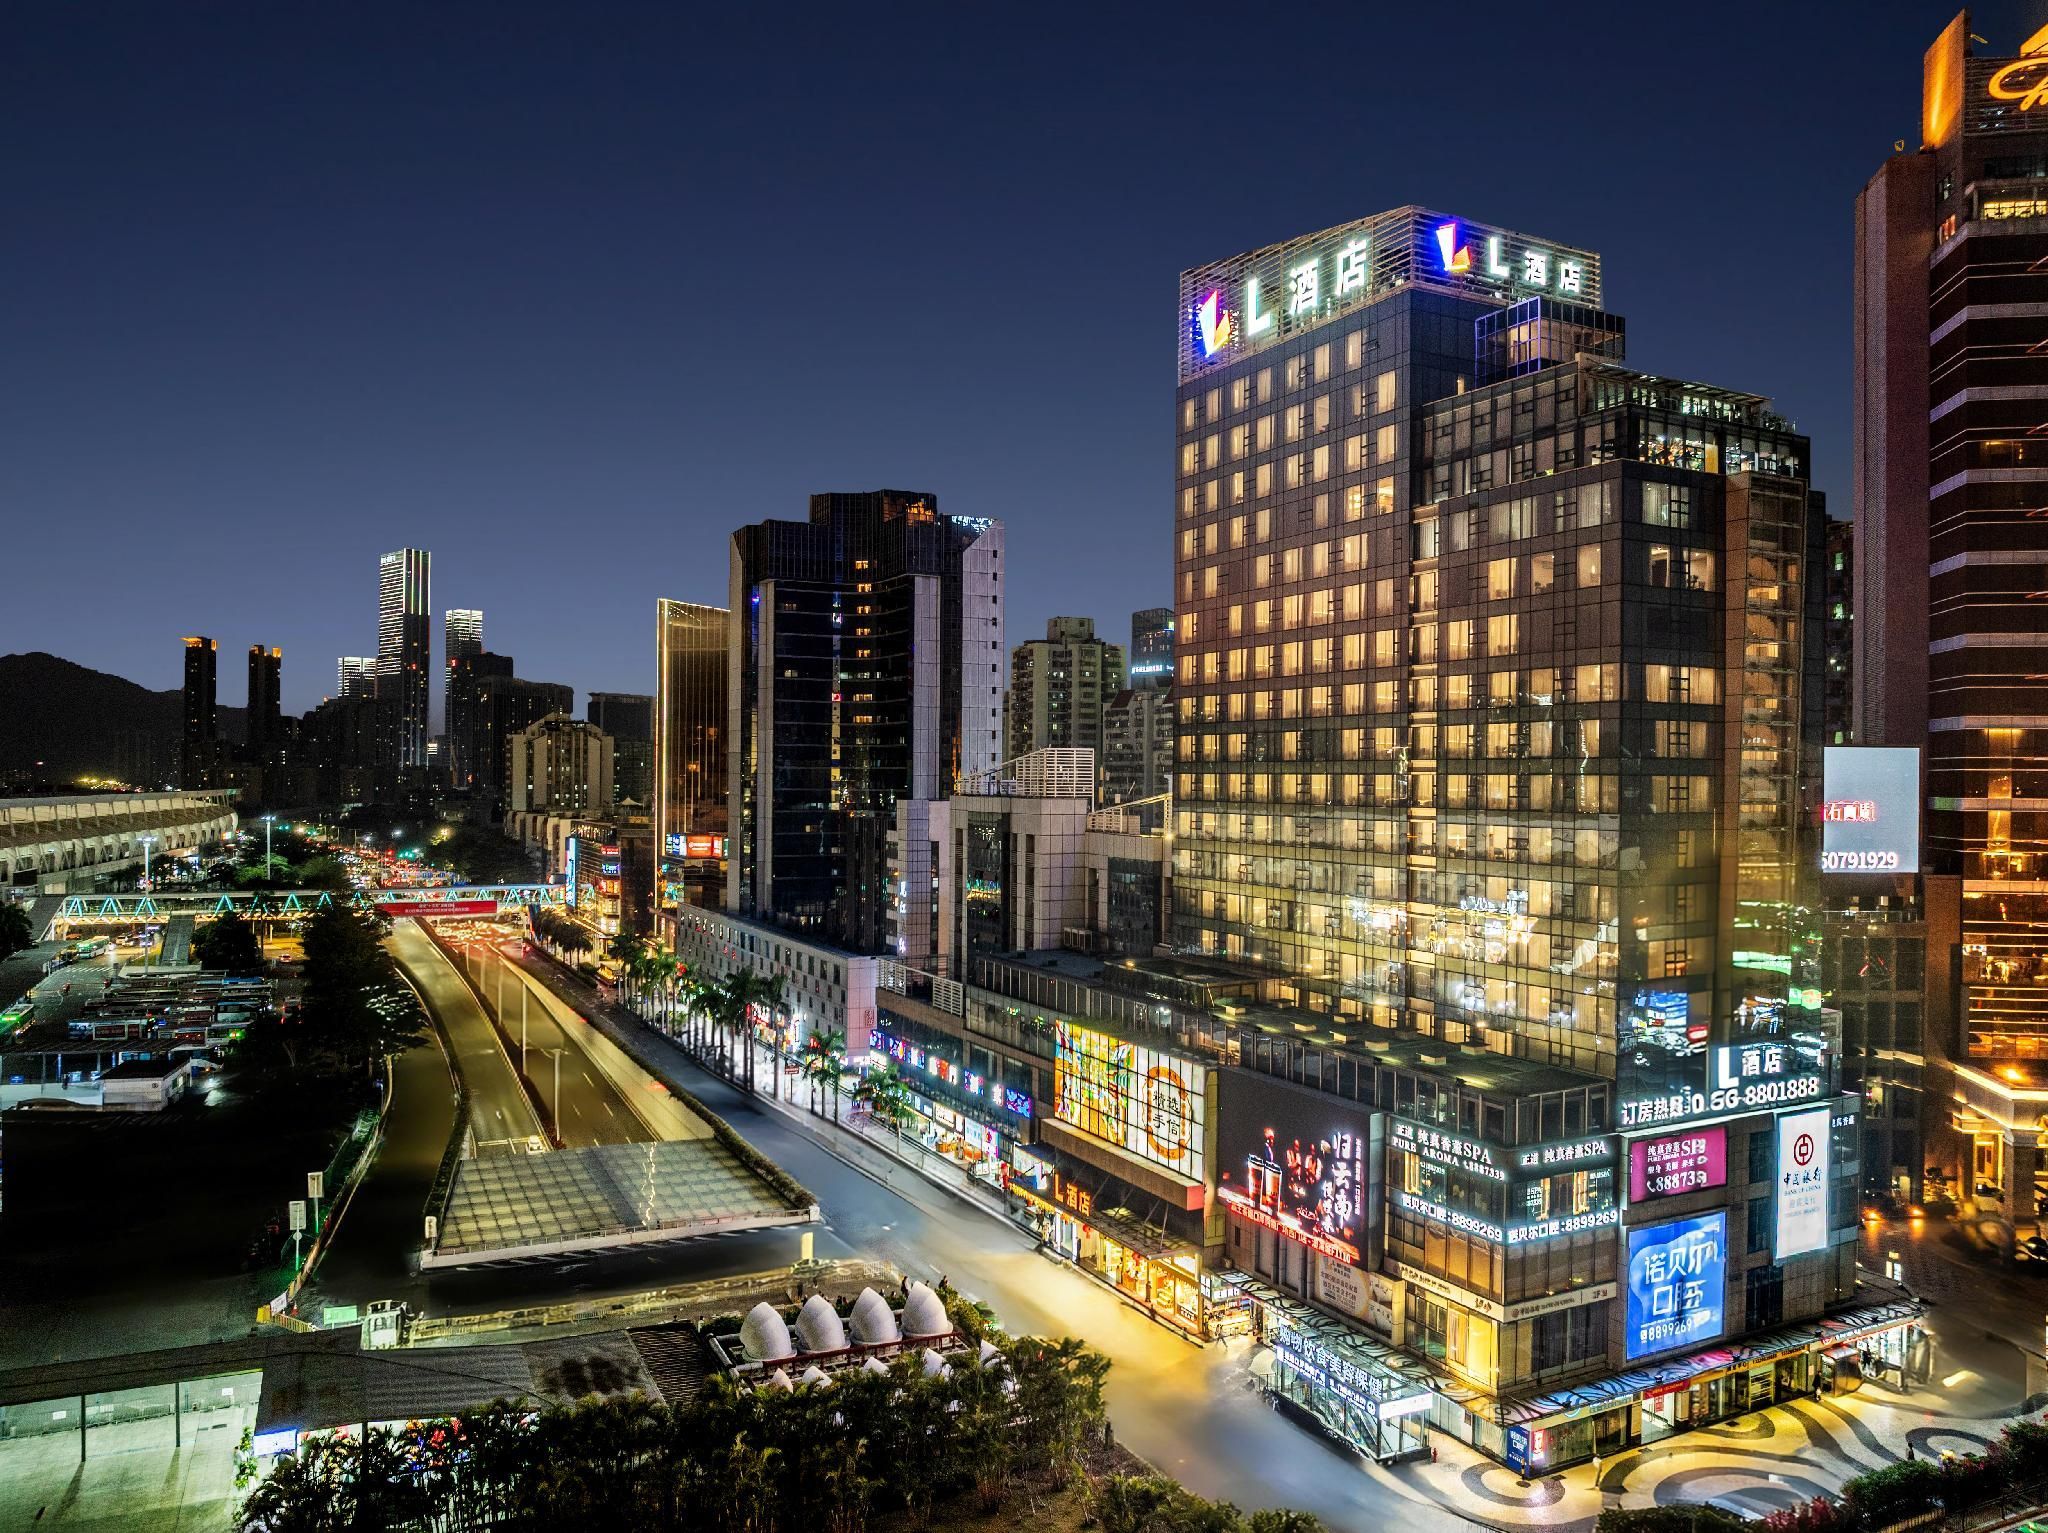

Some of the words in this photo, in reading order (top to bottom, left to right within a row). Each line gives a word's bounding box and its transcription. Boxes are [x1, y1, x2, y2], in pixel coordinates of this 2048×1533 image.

[1392, 1136, 1417, 1153] PURE
[1422, 1146, 1460, 1166] AROMA
[1648, 1319, 1692, 1341] 8899269
[1279, 1325, 1383, 1400] 购物饮食美容保健
